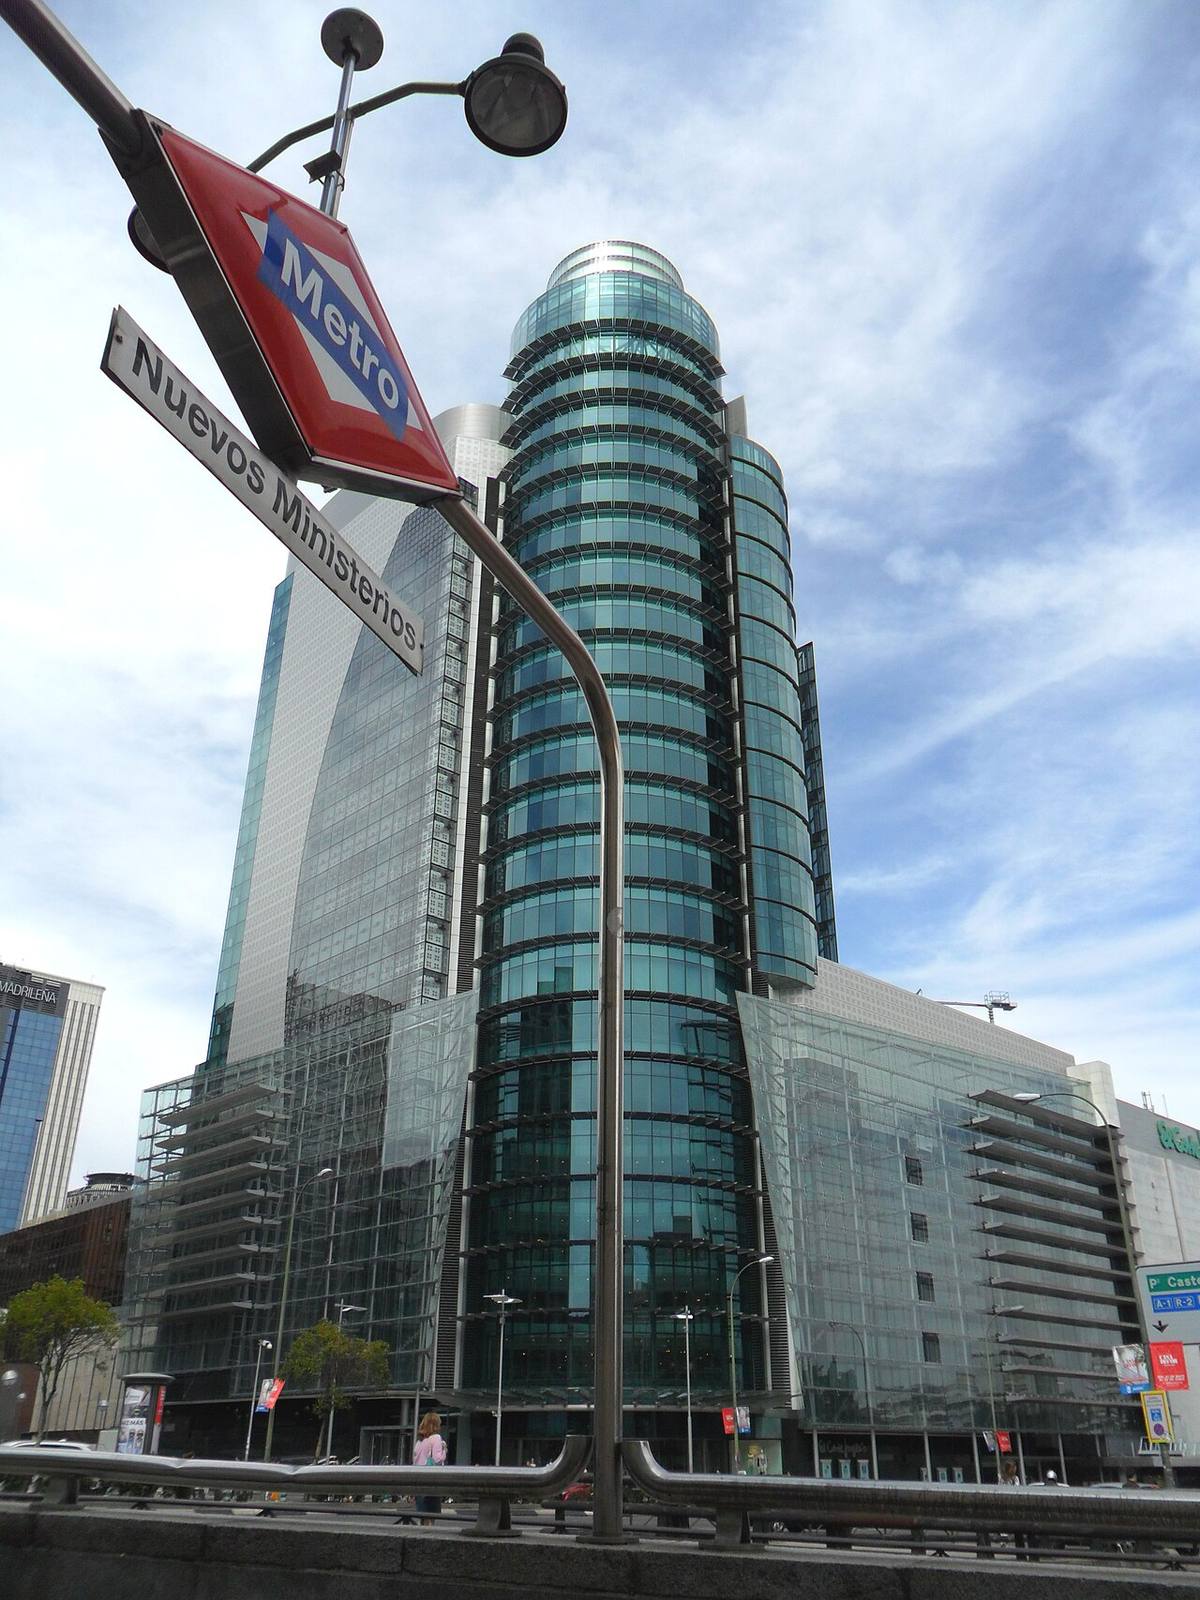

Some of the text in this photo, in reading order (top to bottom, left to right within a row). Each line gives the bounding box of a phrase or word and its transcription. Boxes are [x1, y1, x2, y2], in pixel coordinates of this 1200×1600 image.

[280, 238, 399, 410] Metro
[132, 337, 416, 651] Nuevos Ministerios
[1175, 1296, 1193, 1308] R-2
